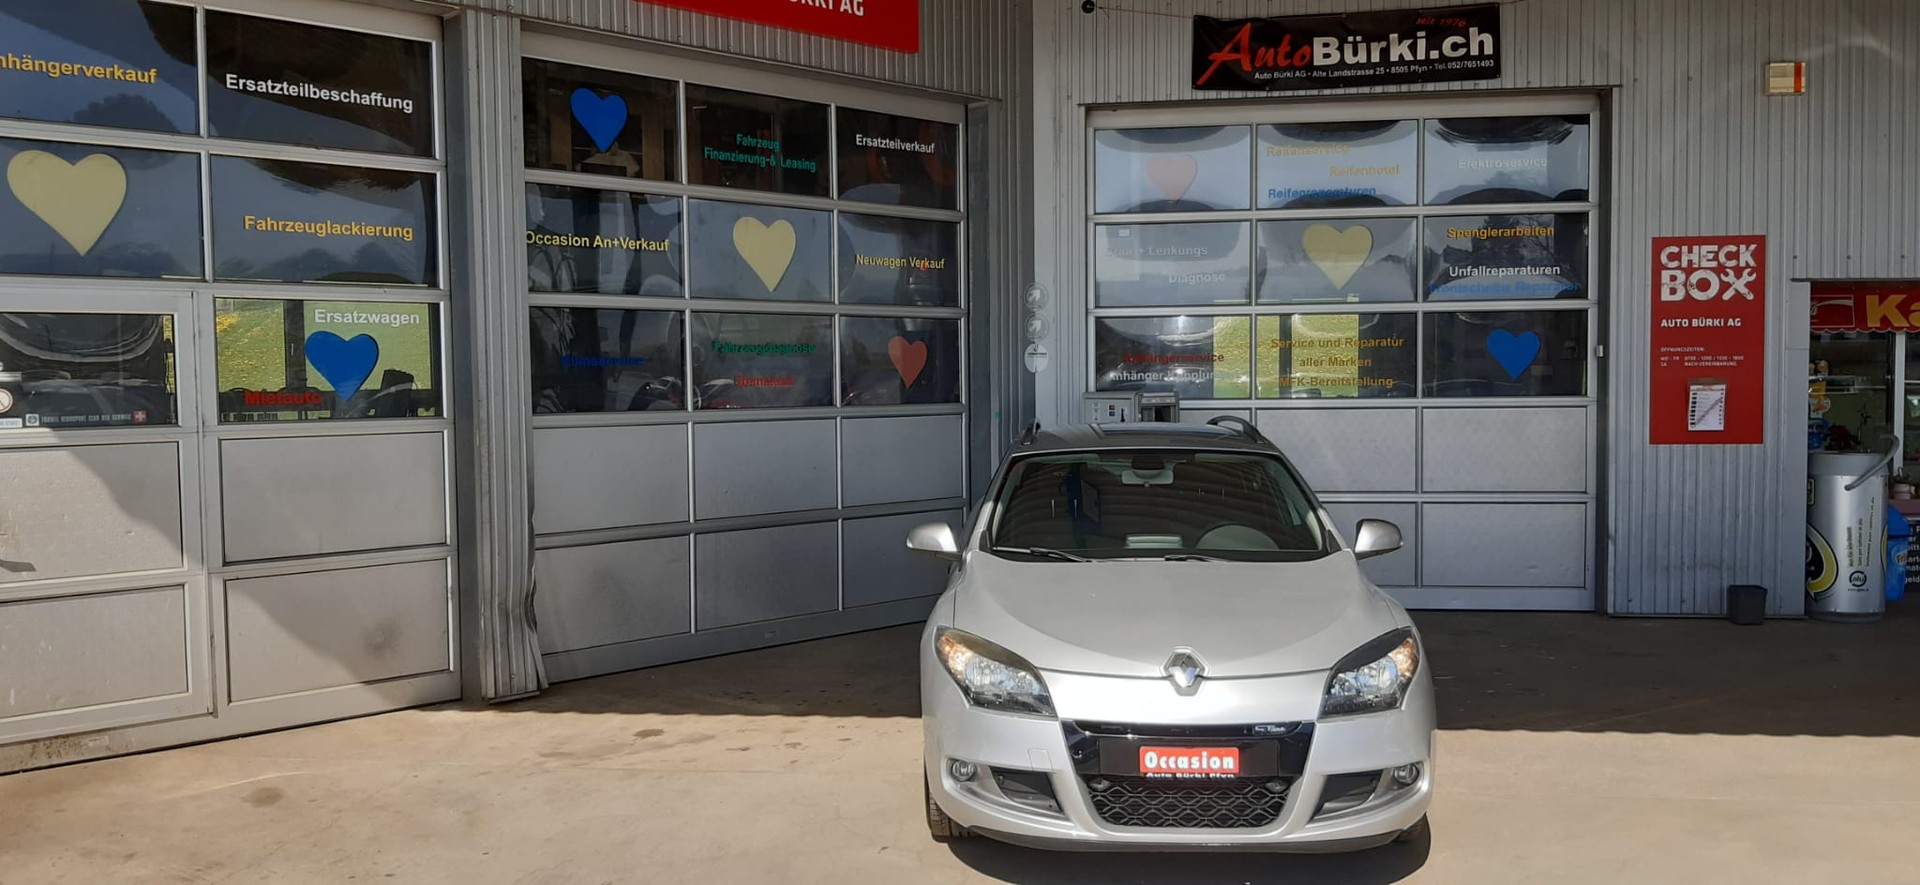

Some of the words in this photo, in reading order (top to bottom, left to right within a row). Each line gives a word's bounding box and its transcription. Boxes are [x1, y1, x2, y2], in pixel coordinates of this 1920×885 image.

[1274, 70, 1294, 78] Bürki
[1328, 68, 1374, 77] Landstrasse
[1410, 64, 1428, 73] Pfyn
[225, 73, 413, 114] Ersatzteilbeschaffung
[736, 134, 780, 152] Fahrzeug
[856, 134, 936, 154] Ersatzteilverkauf
[1266, 144, 1349, 156] Reifenservice
[780, 156, 816, 173] Leasing
[1330, 165, 1400, 176] Reifenhotel
[1458, 158, 1548, 169] Elektroservice
[1268, 186, 1376, 200] Reifenreparaturen
[244, 215, 413, 240] Fahrzeuglackierung
[1447, 226, 1555, 240] Spenglerarbeiten
[525, 230, 590, 248] Occasion
[592, 234, 669, 252] An+Verkauf
[1148, 245, 1208, 258] Lenkungs
[1660, 244, 1758, 268] CHECK
[856, 254, 906, 269] Neuwagen
[909, 256, 945, 270] Verkauf
[1168, 272, 1226, 284] Diagnose
[1450, 264, 1561, 278] Unfallreparaturen
[314, 309, 420, 328] Ersatzwagen
[1660, 318, 1688, 328] AUTO
[1692, 317, 1724, 327] BÜRKI
[1727, 318, 1741, 326] AG
[1270, 338, 1314, 348] Service
[1318, 338, 1340, 348] und
[1344, 338, 1404, 348] Reparatur
[1300, 358, 1325, 367] aller
[1328, 358, 1372, 366] Marken
[1109, 370, 1164, 382] nhänger
[1279, 376, 1394, 389] MFK-Bereitstellung
[244, 390, 322, 404] Mietauto
[1144, 751, 1234, 770] Occasion
